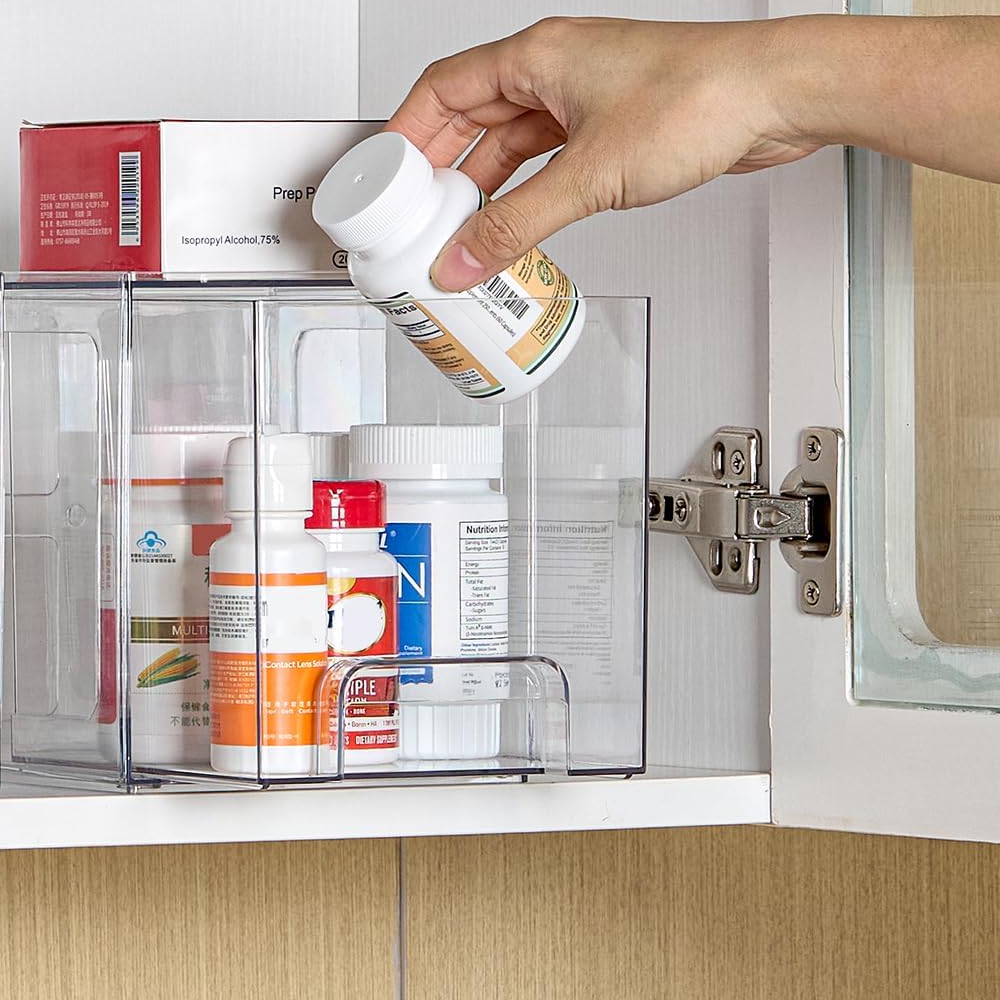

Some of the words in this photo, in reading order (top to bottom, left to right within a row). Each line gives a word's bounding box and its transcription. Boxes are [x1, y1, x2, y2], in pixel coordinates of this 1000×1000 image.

[272, 186, 303, 203] Prep
[181, 235, 223, 247] Isopropyl
[466, 525, 498, 534] Nutrition
[297, 660, 313, 669] Lens
